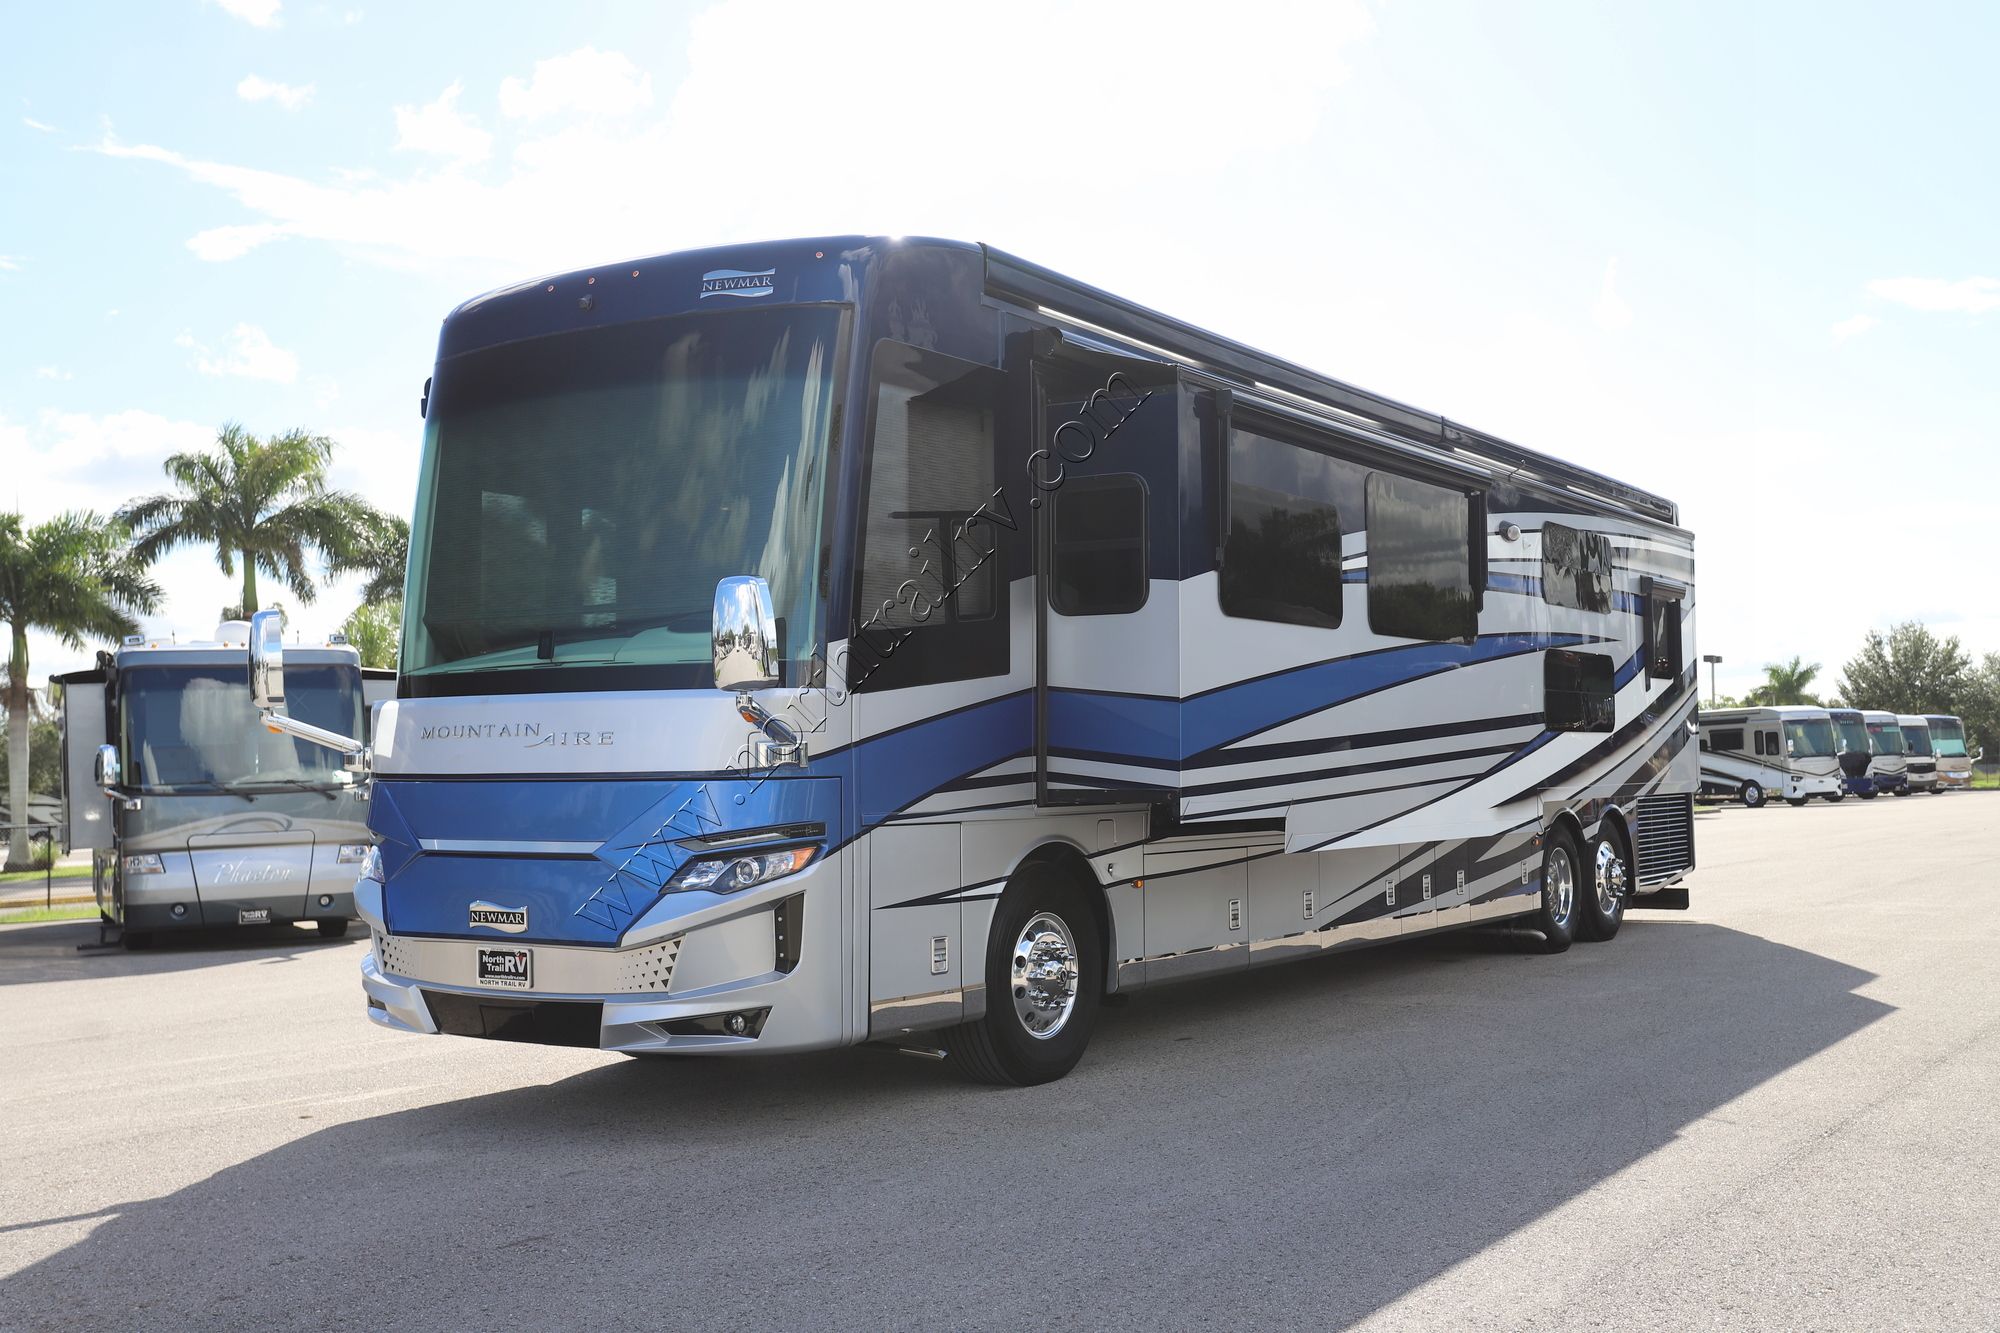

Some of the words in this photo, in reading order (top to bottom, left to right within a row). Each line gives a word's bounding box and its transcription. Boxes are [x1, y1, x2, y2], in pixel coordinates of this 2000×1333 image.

[702, 276, 773, 291] NEWMAR
[420, 723, 541, 740] MOUNTAIN
[524, 731, 615, 748] AIRE
[471, 911, 524, 924] NEWMAR
[483, 955, 504, 963] North
[505, 956, 526, 973] RV
[487, 963, 504, 971] Trail
